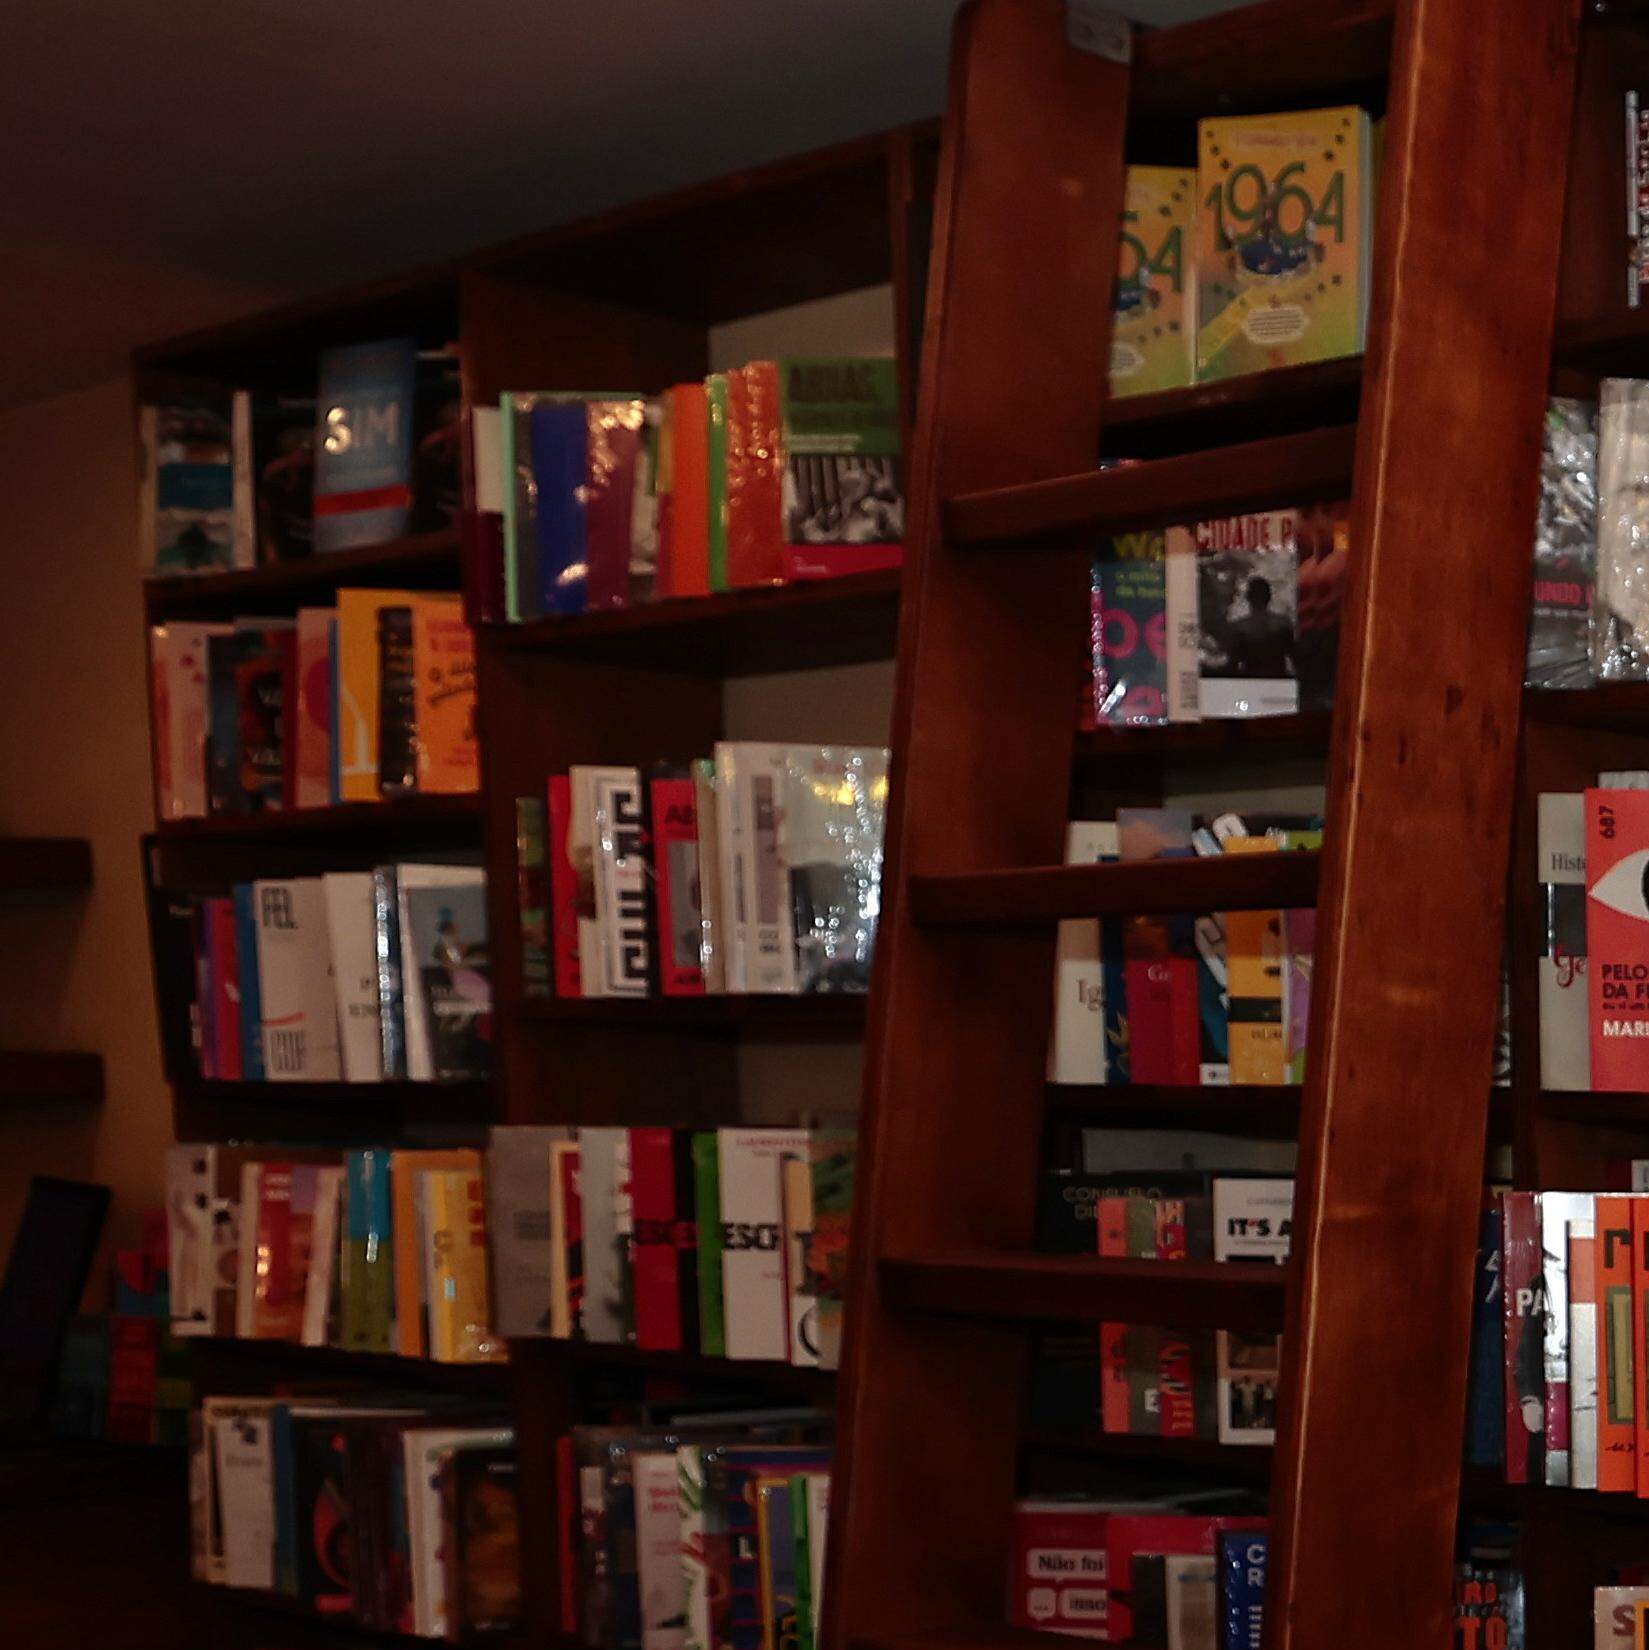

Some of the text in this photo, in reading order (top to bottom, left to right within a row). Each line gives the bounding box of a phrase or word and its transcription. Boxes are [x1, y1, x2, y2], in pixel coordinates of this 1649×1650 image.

[1206, 161, 1346, 252] 1964
[1601, 964, 1648, 981] PELO
[1602, 983, 1628, 1000] DA
